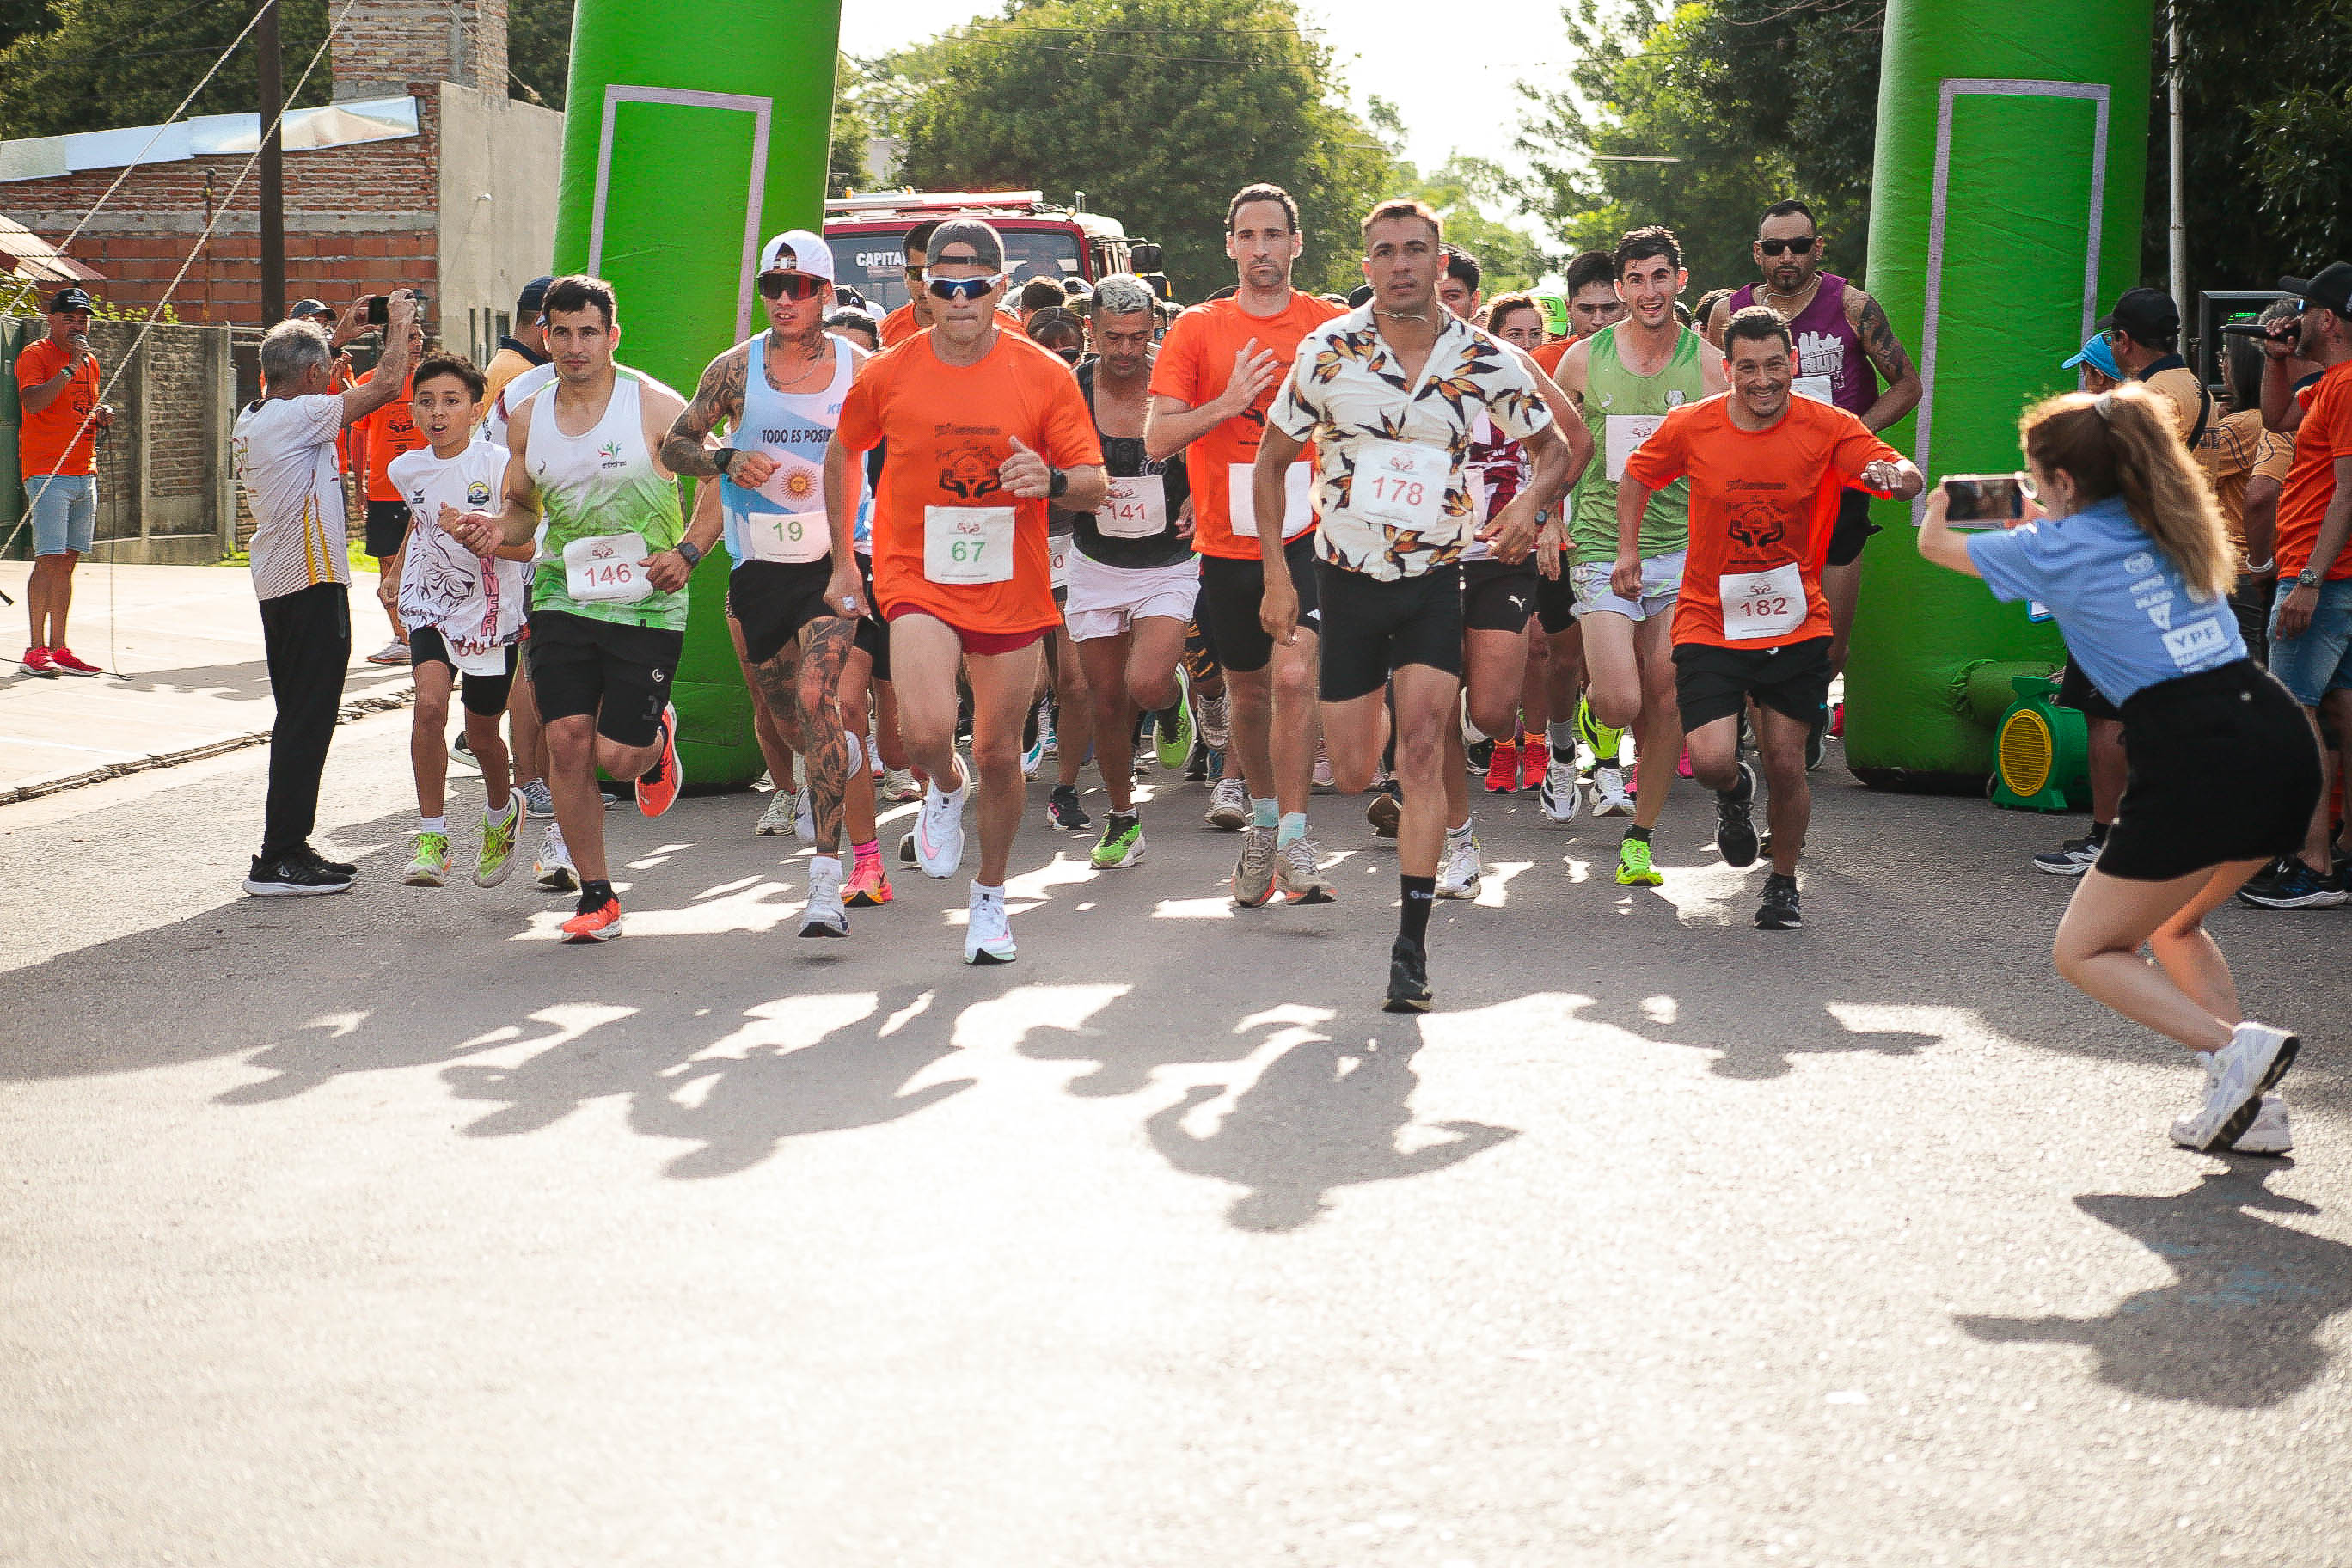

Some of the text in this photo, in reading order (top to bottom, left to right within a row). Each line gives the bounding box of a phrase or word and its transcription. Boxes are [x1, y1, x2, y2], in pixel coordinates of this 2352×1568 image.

[1801, 352, 1843, 372] RUN
[762, 429, 788, 444] TODO
[791, 429, 801, 443] ES
[1372, 476, 1424, 506] 178
[1109, 502, 1146, 521] 141
[773, 521, 803, 542] 19
[952, 541, 986, 562] 67
[1051, 554, 1064, 568] 0
[585, 563, 632, 587] 146
[1739, 597, 1788, 617] 182
[2173, 625, 2216, 649] YPF
